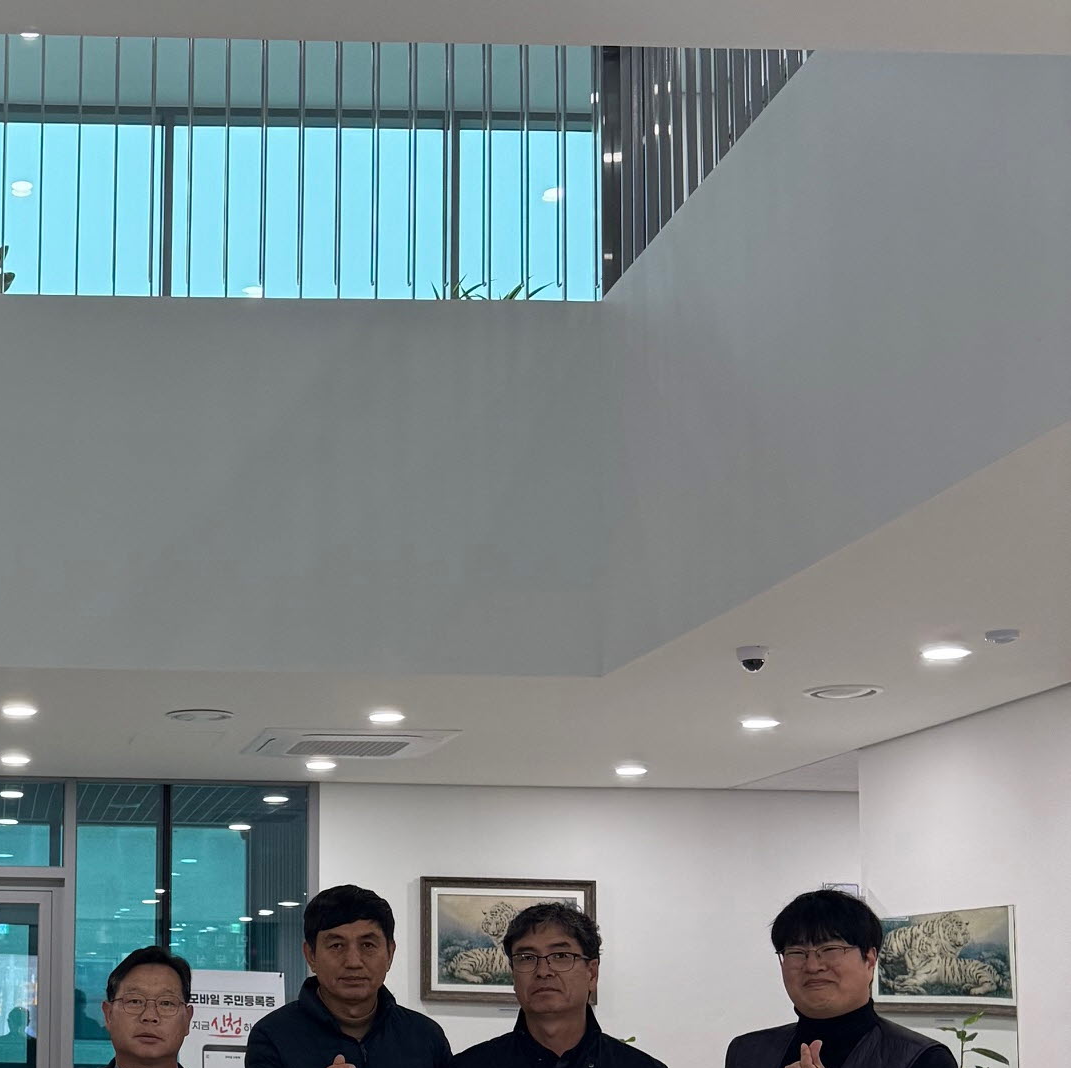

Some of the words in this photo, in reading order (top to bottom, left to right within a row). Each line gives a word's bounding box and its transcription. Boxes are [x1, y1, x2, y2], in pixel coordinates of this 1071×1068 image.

[189, 993, 220, 1006] 모바일
[223, 994, 276, 1008] 주민등록증
[192, 1020, 210, 1031] 지금
[211, 1012, 242, 1035] 신청
